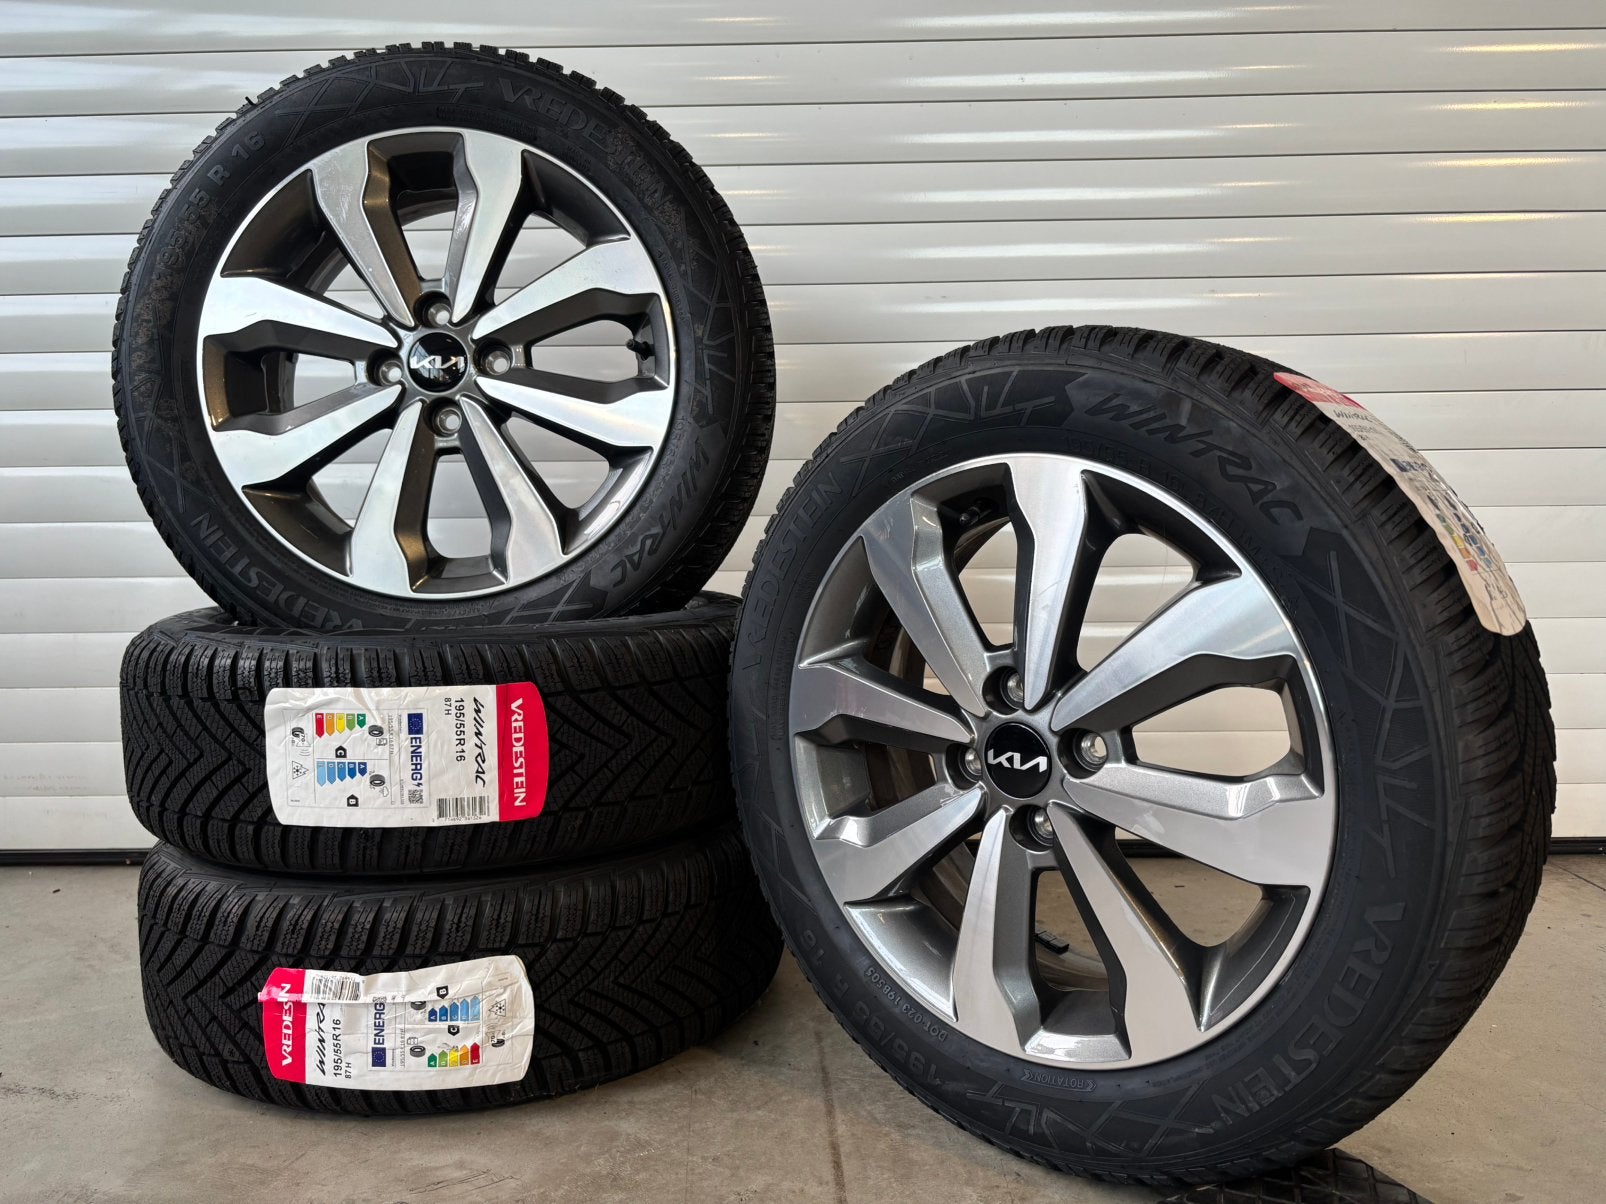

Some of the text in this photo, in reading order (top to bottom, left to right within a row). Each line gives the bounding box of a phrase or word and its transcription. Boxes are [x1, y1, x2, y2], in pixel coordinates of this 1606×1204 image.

[208, 164, 232, 187] R
[233, 129, 265, 161] 16
[410, 355, 465, 369] KIA
[1084, 392, 1303, 526] WINTRAC
[611, 434, 710, 589] WINTRAC
[473, 696, 487, 788] WINTRAC
[510, 697, 527, 807] VREDESTEIN
[987, 748, 1048, 772] KIA
[315, 1003, 326, 1076] WINTRA
[1219, 901, 1407, 1125] VREDESTEIN
